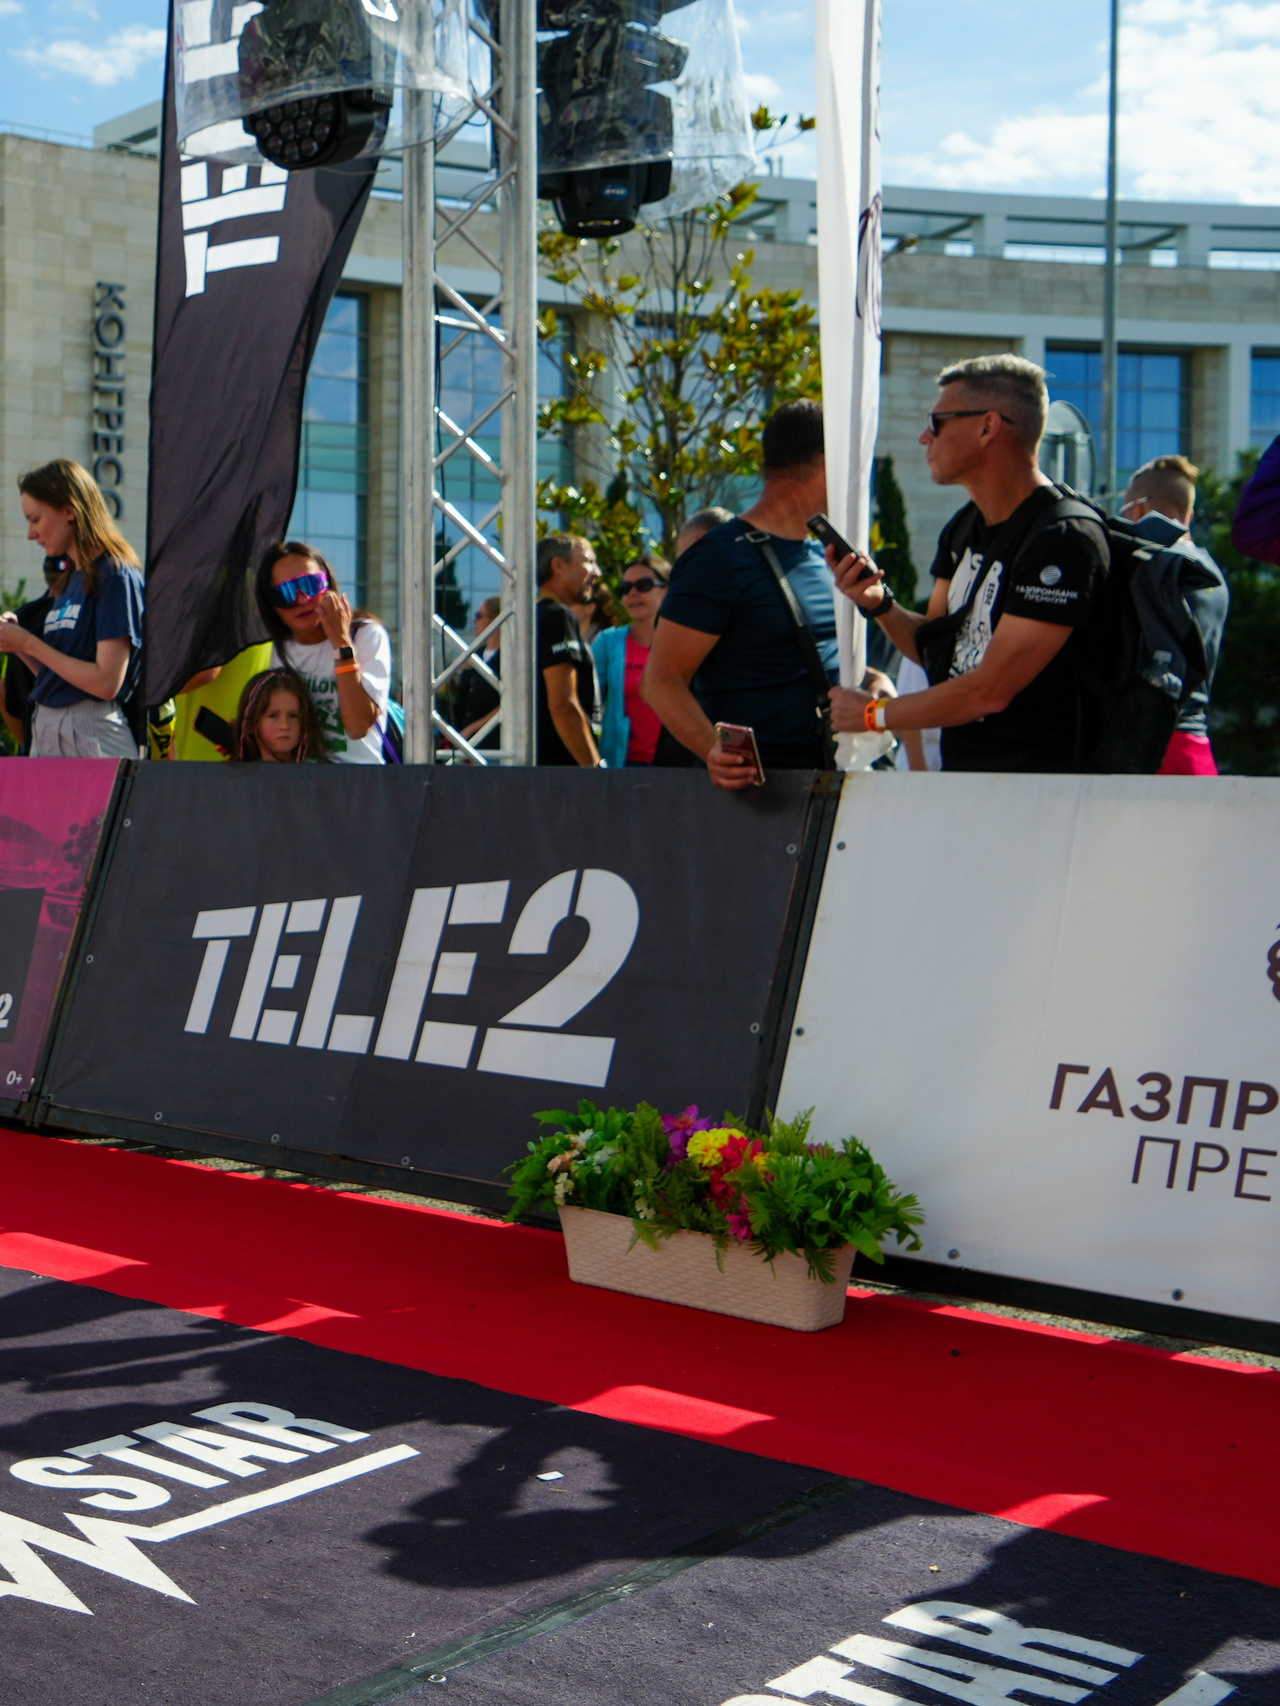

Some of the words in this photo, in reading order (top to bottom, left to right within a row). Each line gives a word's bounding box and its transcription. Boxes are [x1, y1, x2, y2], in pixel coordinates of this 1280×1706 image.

[184, 868, 640, 1088] TELE2
[6, 1070, 23, 1086] 0+
[1049, 1062, 1280, 1131] ГАЗПР
[1131, 1134, 1279, 1202] ПРЕ
[9, 1401, 371, 1512] STAR
[720, 1601, 1146, 1706] TAR
